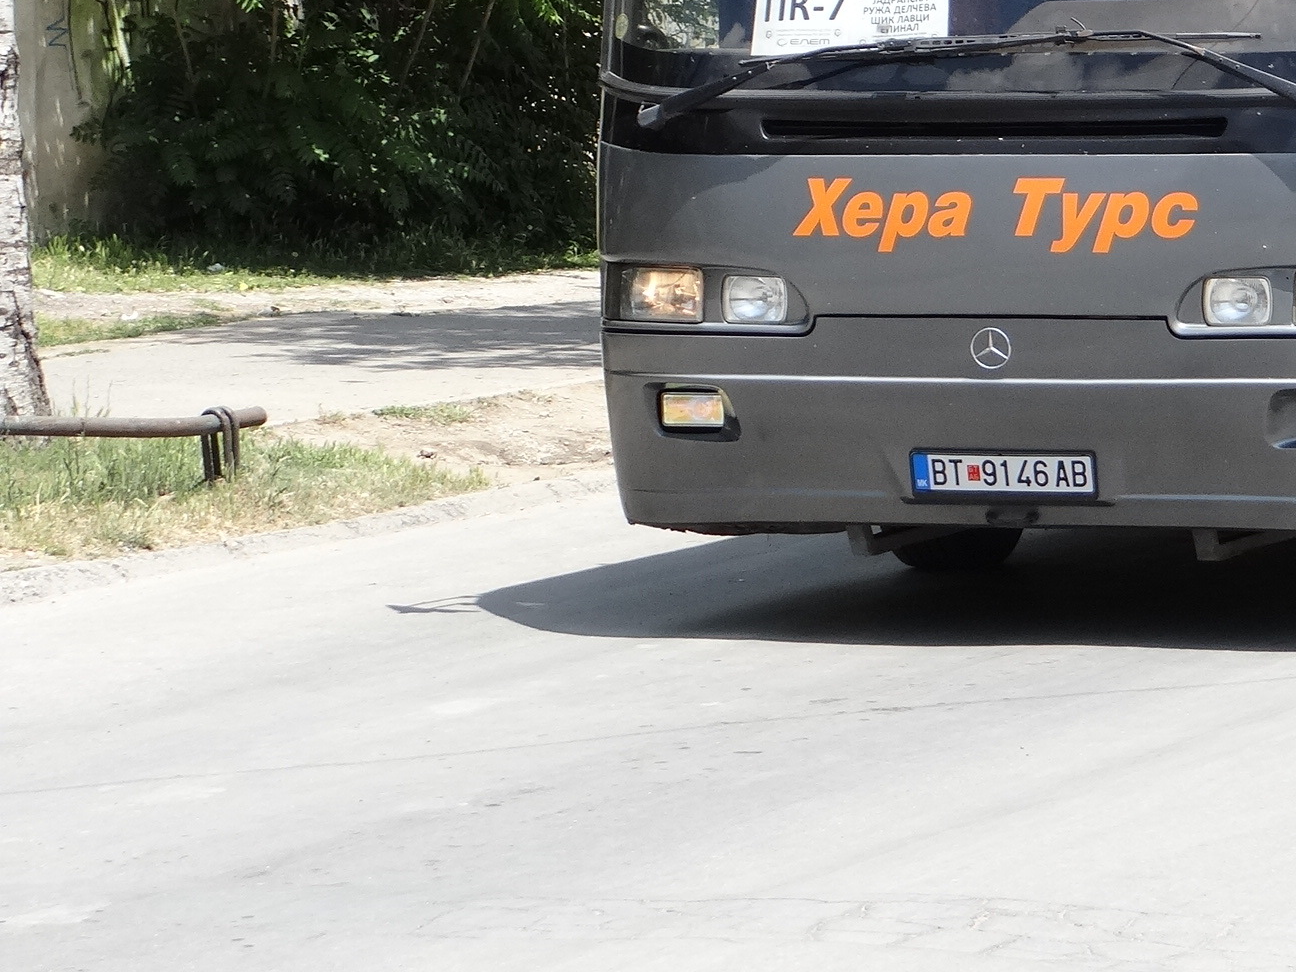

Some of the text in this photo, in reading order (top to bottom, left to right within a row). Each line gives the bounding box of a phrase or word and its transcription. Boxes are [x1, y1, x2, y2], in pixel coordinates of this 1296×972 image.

[863, 3, 937, 15] РУЖА ДЕЛЧЕВА
[871, 14, 930, 25] ШИК ЛАВЦИ
[793, 177, 1200, 254] Хера Турс
[931, 459, 962, 486] BT
